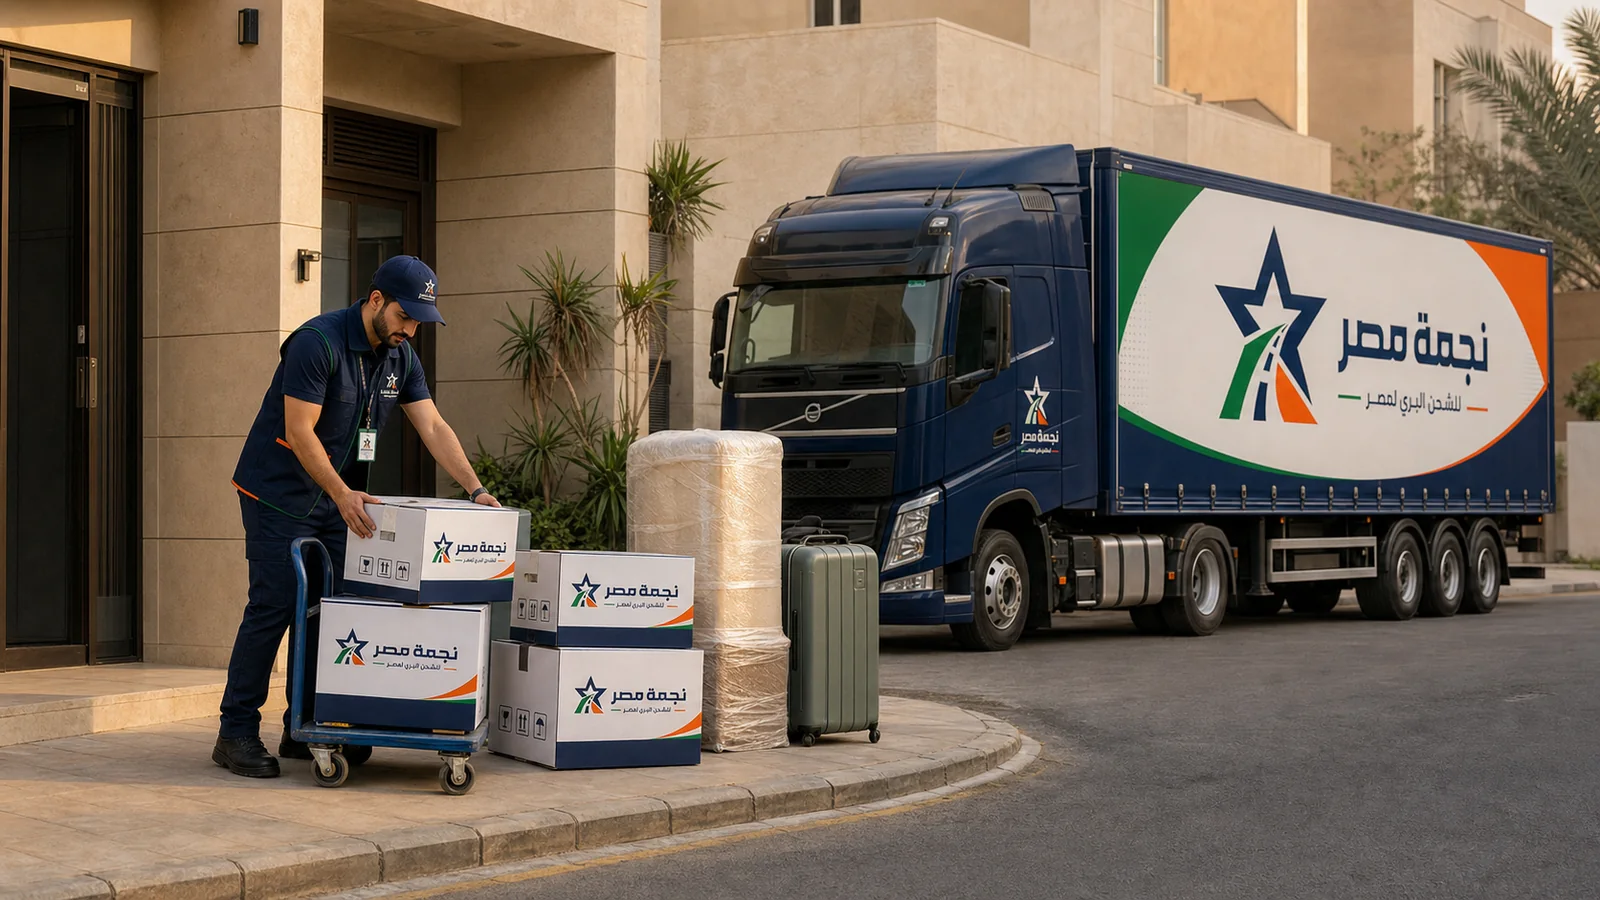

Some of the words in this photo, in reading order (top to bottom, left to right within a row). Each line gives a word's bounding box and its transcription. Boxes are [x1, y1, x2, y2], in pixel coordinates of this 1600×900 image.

[1337, 317, 1408, 373] مصر
[1413, 312, 1489, 386] نجمة
[1365, 389, 1397, 410] لمصر
[1399, 391, 1426, 417] البري
[1427, 392, 1461, 415] للشحن
[1020, 432, 1037, 445] مصر
[455, 544, 478, 556] مصر
[479, 541, 507, 557] نجمة
[604, 586, 637, 600] مصر
[639, 584, 679, 602] نجمة
[372, 645, 410, 658] مصر
[413, 644, 458, 664] نجمة
[610, 691, 644, 705] مصر
[646, 687, 687, 705] نجمة
